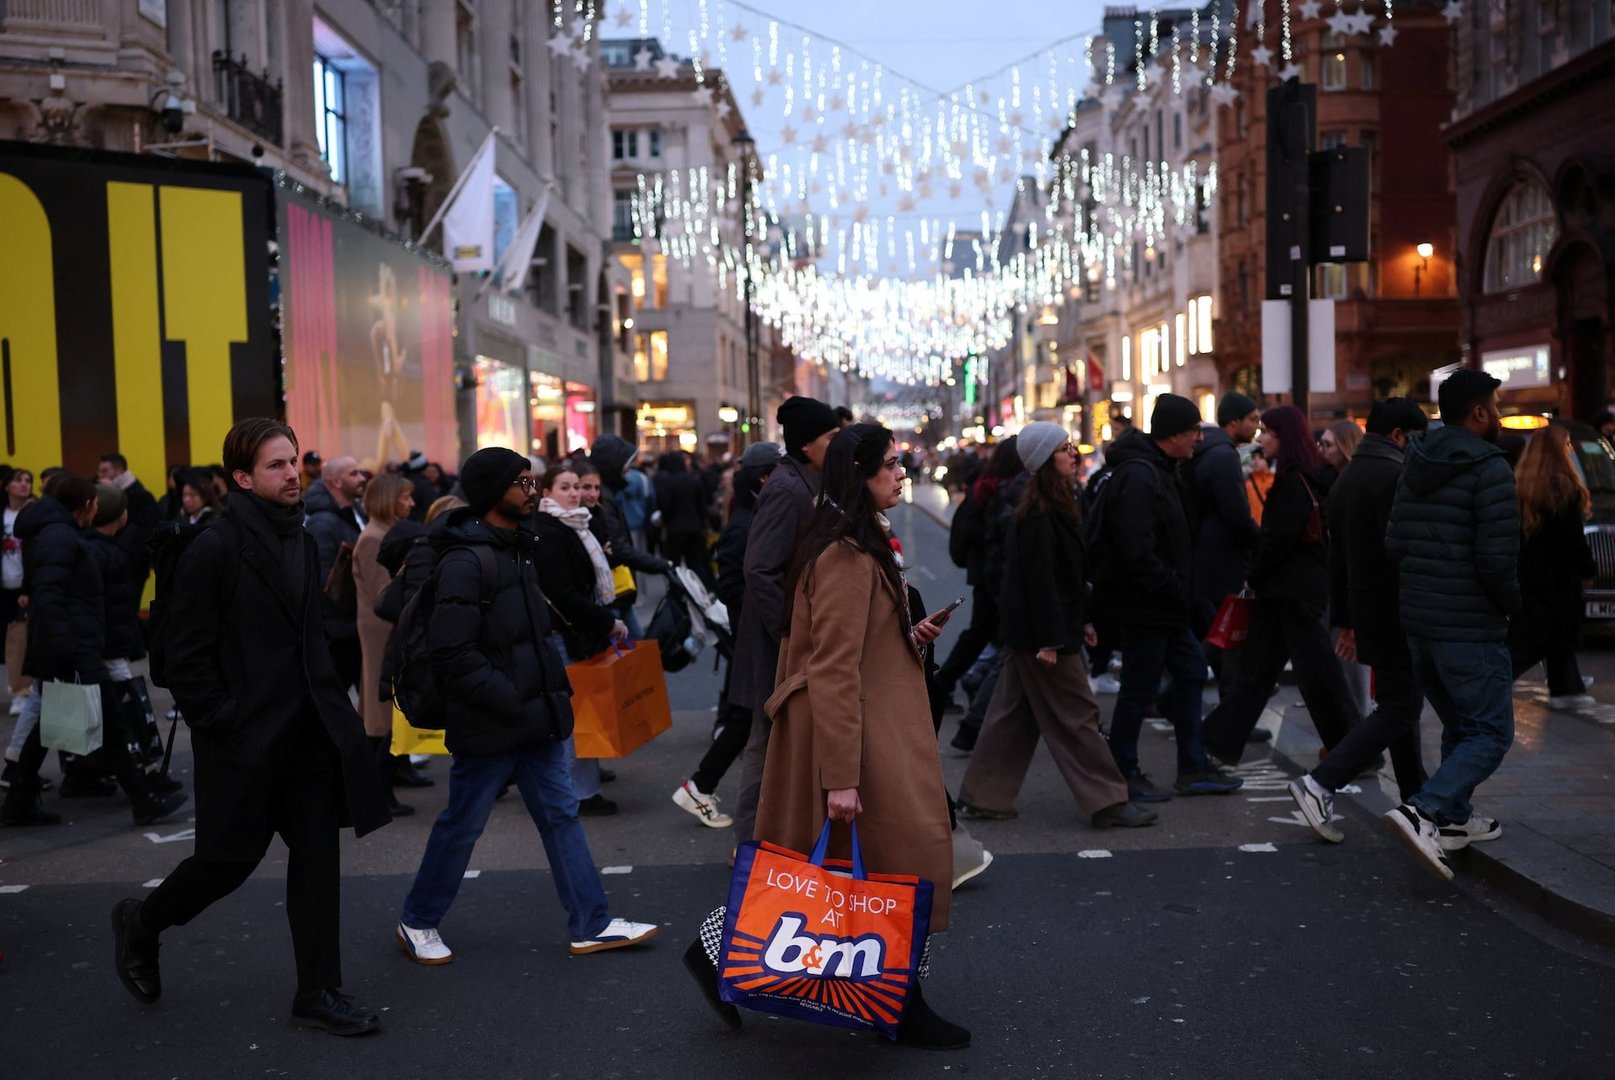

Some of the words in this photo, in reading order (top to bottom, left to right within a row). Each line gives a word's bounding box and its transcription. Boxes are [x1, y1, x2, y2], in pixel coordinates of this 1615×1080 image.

[766, 868, 818, 898] LOVE
[824, 885, 845, 908] TO
[848, 894, 897, 915] SHOP
[820, 908, 844, 929] AT
[764, 915, 881, 978] b&m
